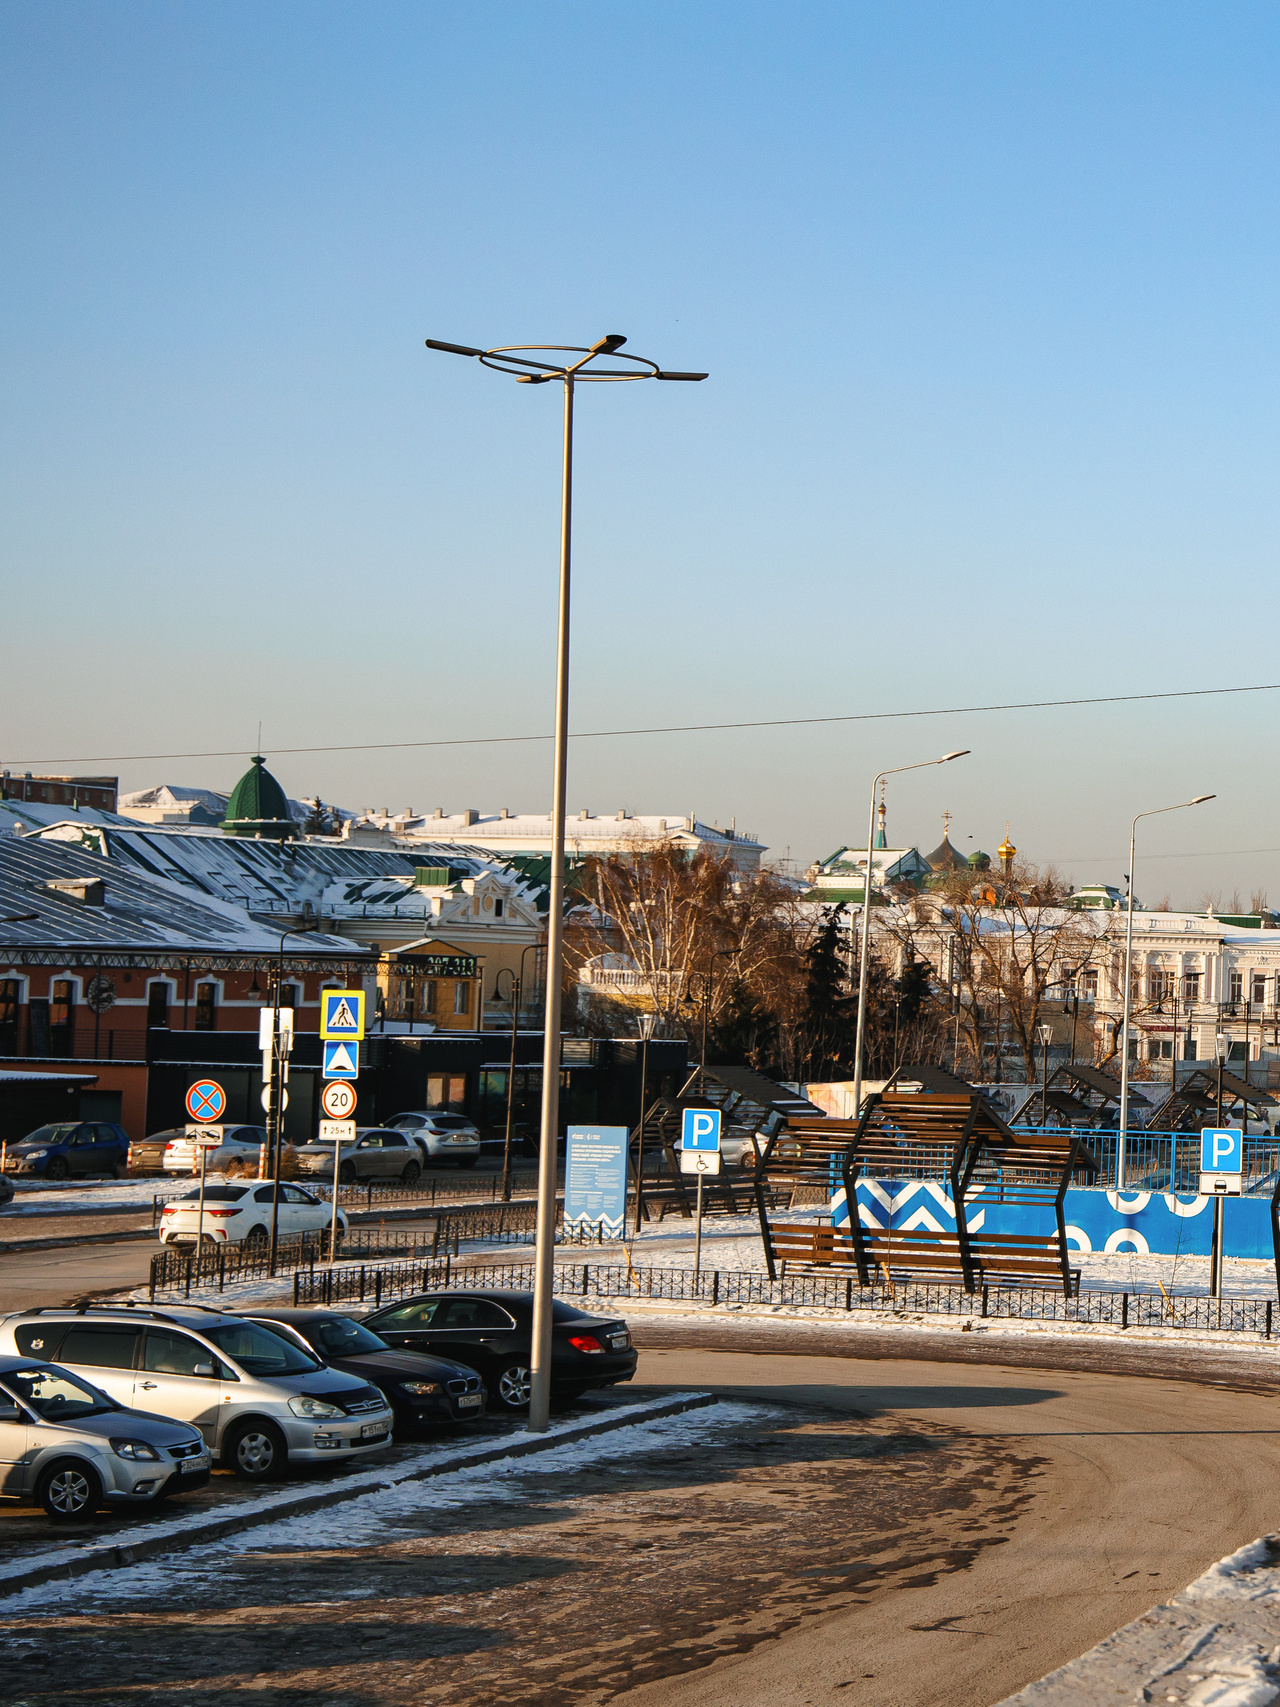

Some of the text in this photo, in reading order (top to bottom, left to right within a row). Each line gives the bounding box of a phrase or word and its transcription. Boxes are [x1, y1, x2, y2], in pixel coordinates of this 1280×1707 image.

[331, 1093, 348, 1106] 20
[693, 1114, 714, 1146] P
[1212, 1133, 1235, 1167] P
